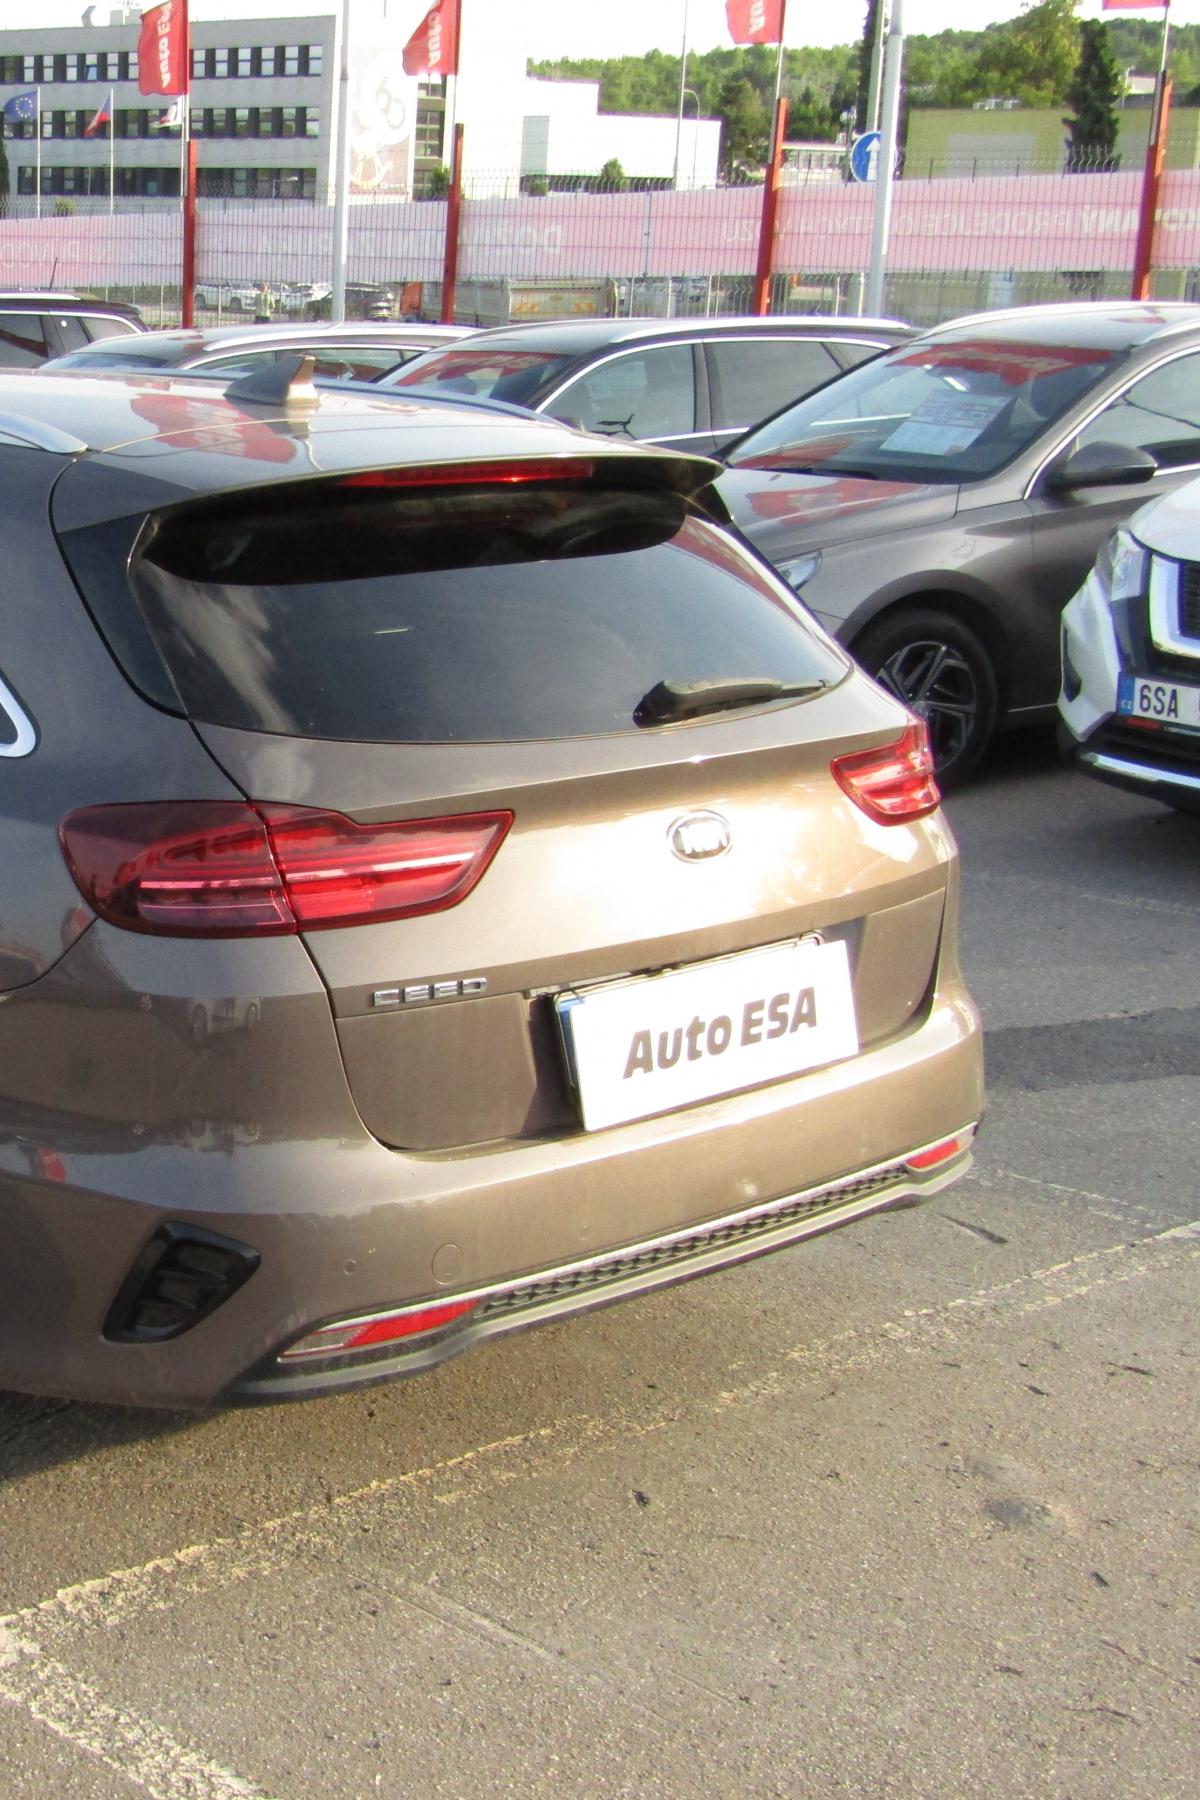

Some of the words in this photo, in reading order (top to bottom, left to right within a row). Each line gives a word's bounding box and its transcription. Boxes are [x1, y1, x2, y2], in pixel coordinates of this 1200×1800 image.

[1139, 683, 1179, 719] 6SA
[373, 977, 488, 1008] CEED
[622, 1015, 733, 1080] Auto
[740, 986, 818, 1047] ESA
